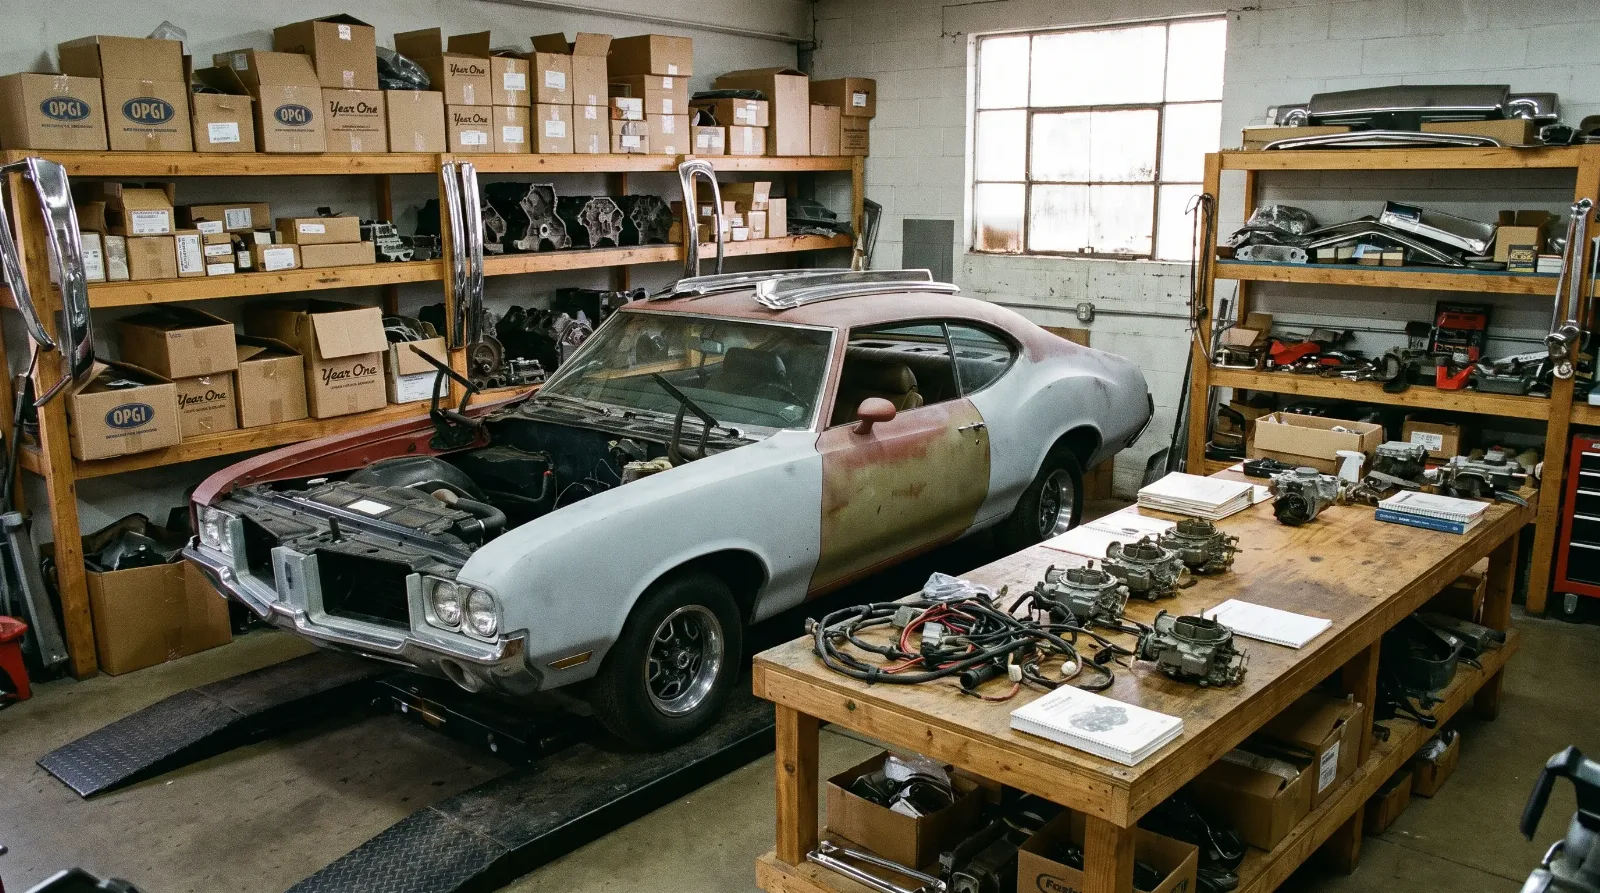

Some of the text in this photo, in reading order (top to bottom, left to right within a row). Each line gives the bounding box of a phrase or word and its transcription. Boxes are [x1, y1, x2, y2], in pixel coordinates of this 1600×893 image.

[449, 63, 485, 77] Year One
[49, 101, 82, 117] OPGI
[131, 102, 165, 120] OPGI
[281, 108, 306, 122] OPGI
[329, 100, 378, 118] Year One
[453, 112, 488, 126] Year One
[321, 367, 351, 386] Year
[352, 363, 378, 377] One
[177, 393, 204, 410] Year
[205, 389, 227, 401] One
[113, 406, 146, 425] OPGI
